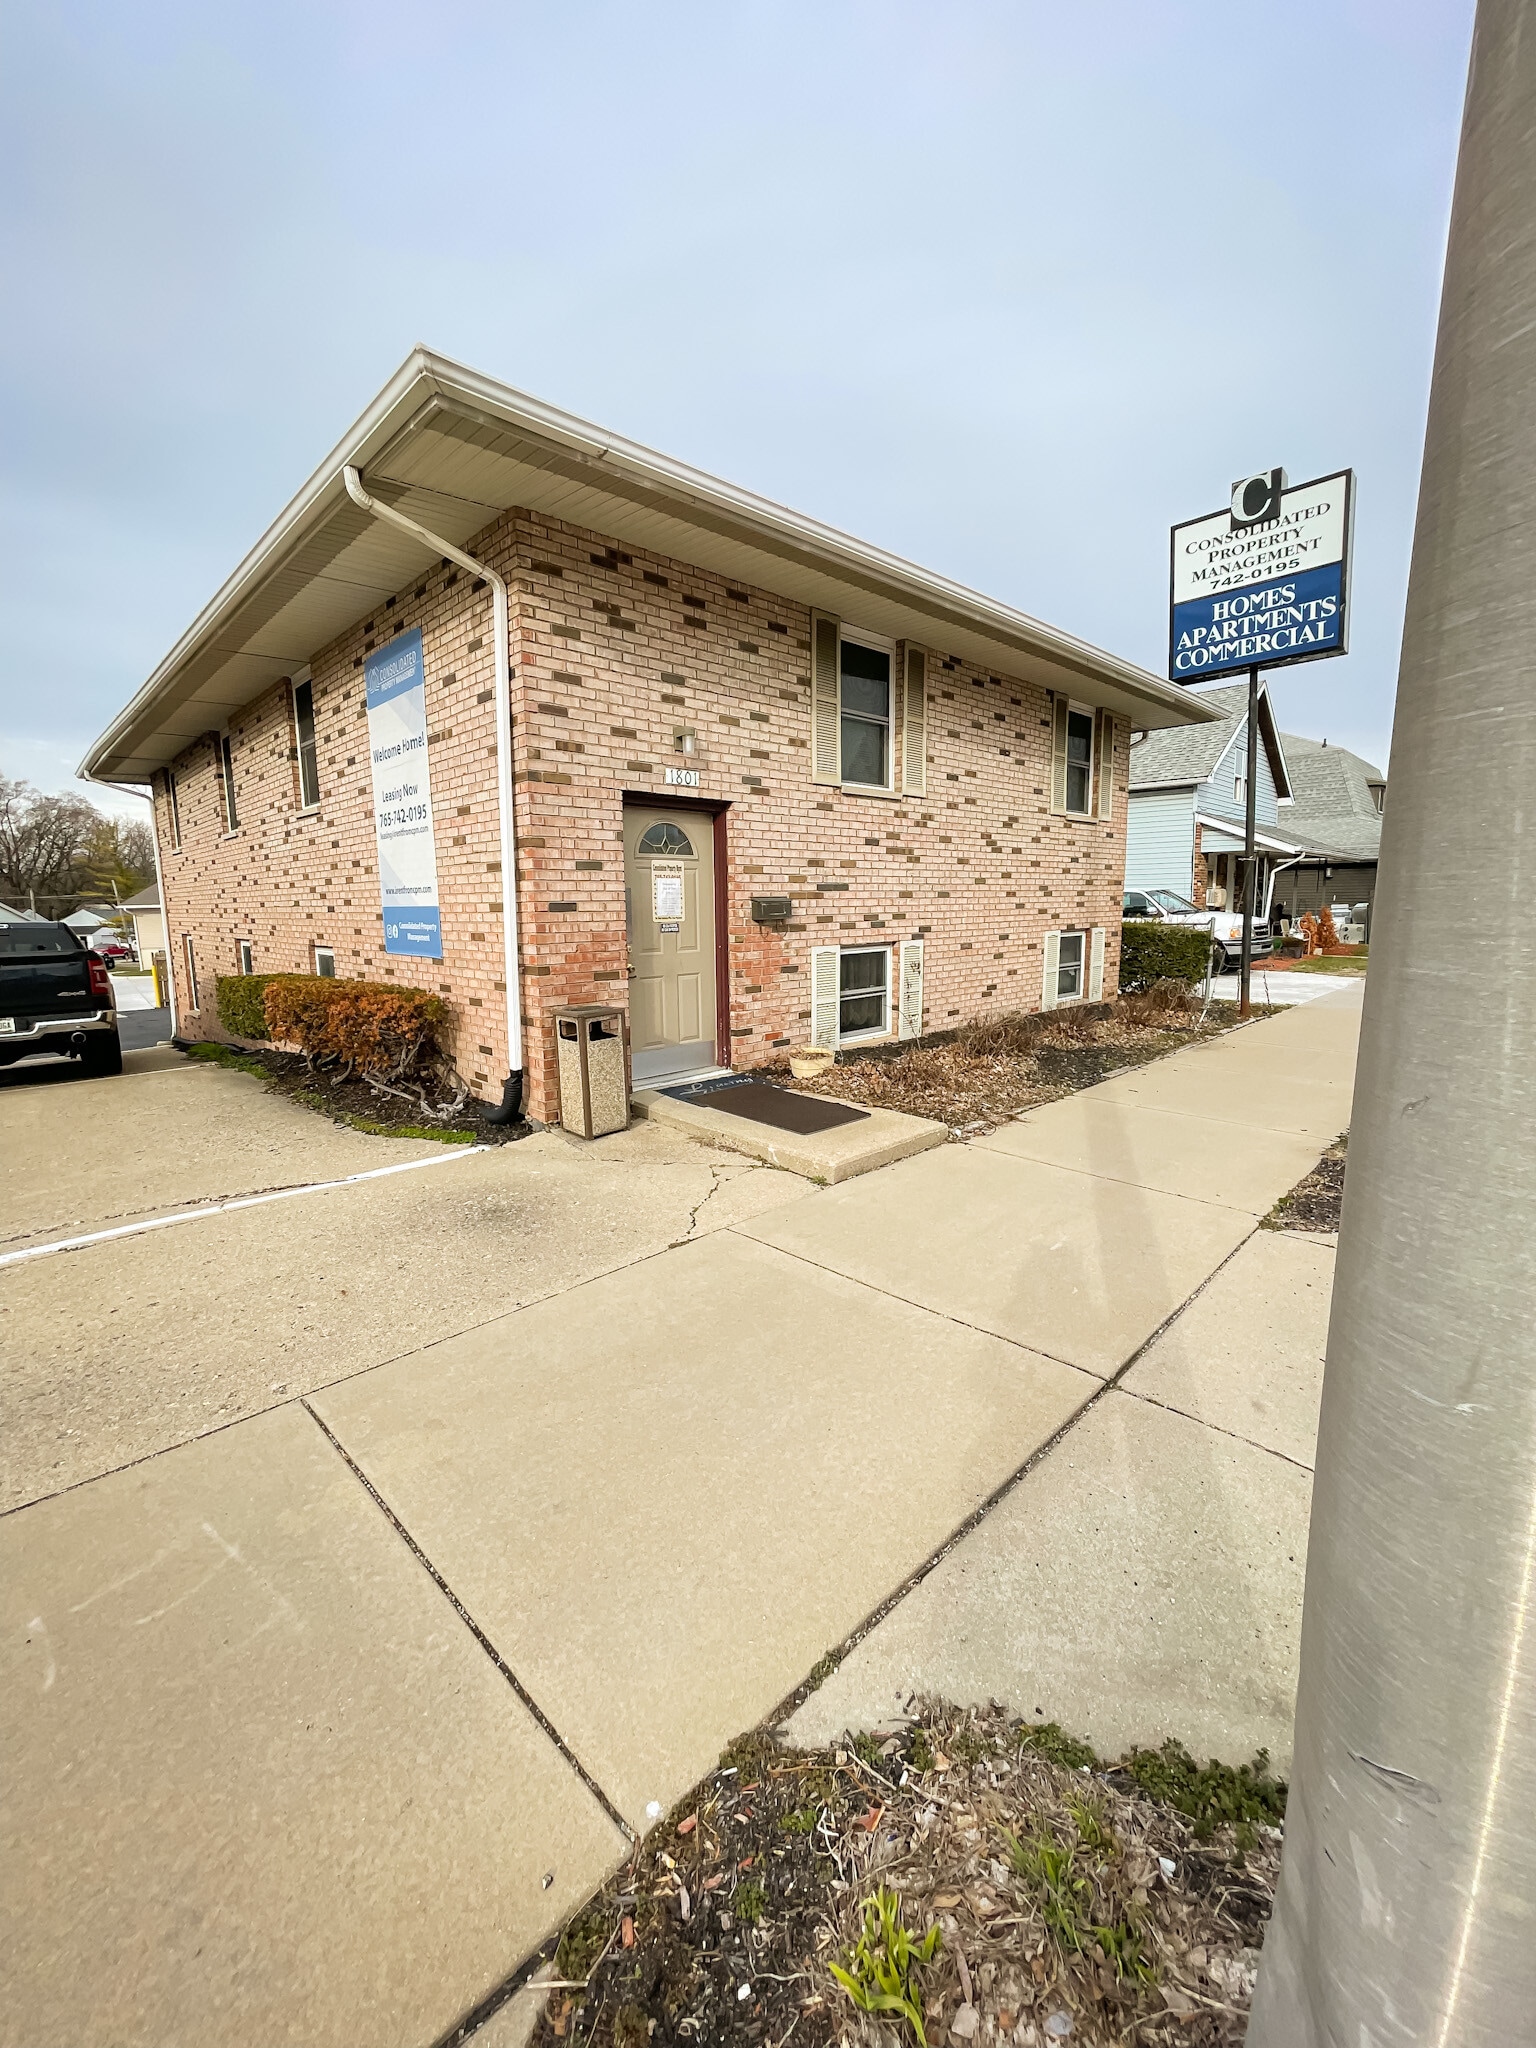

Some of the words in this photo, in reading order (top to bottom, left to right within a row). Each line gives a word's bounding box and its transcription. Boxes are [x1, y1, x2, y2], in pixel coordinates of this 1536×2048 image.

[1231, 470, 1273, 523] C
[1185, 502, 1331, 555] CONSOLIDATED
[1208, 526, 1305, 564] PROPERTY
[1191, 536, 1323, 583] MANAGEMENT
[1210, 558, 1301, 590] 742-0195
[1212, 583, 1297, 622] HOMES
[1176, 595, 1337, 651] APARTMENTS
[1175, 620, 1335, 671] COMMERCIAL
[379, 651, 417, 681] CONSOLIDATED
[373, 744, 401, 763] Welcome
[402, 731, 425, 753] Home!
[382, 787, 402, 803] Leasing
[402, 783, 419, 797] Now
[670, 769, 697, 786] 1801
[379, 804, 427, 828] 765-742-0195
